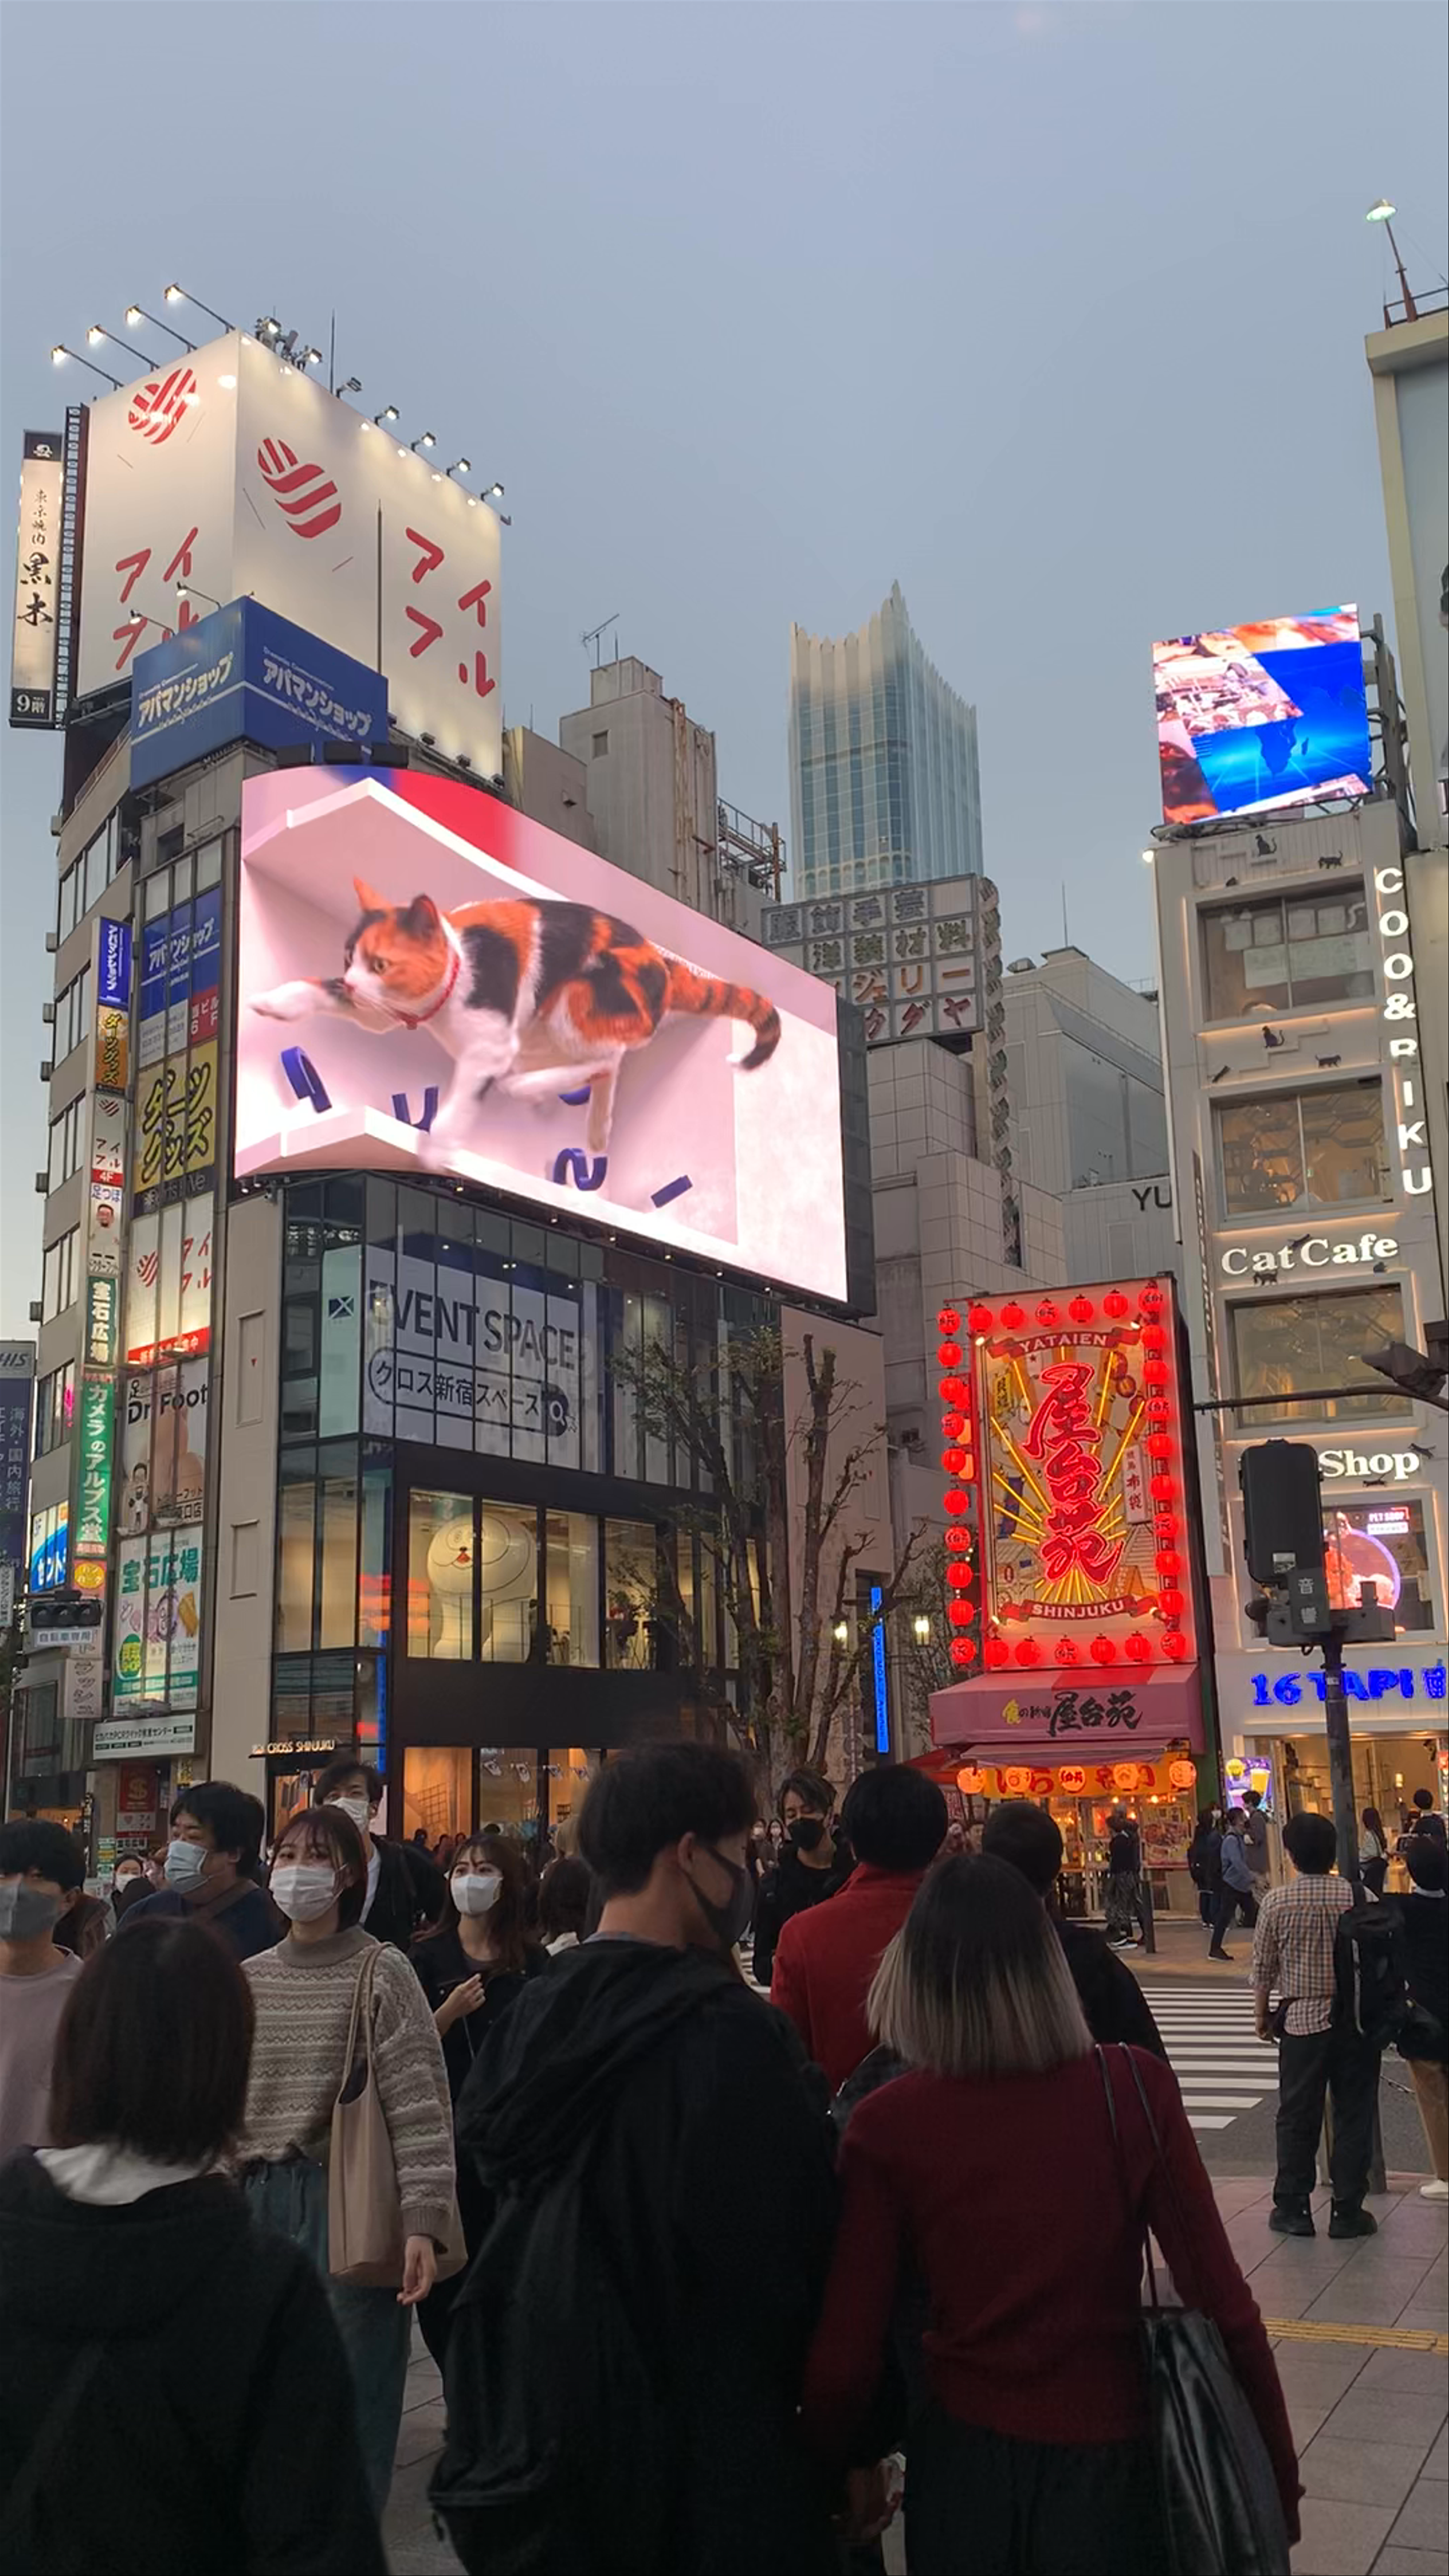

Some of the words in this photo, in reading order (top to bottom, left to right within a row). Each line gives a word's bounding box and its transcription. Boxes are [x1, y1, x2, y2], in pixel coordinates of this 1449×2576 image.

[17, 552, 53, 626] 黒木
[138, 652, 233, 726] アパマンショップ
[264, 658, 372, 736] アパマンショップ
[1221, 1246, 1294, 1275] Cat
[1300, 1233, 1398, 1266] Cafe
[91, 1281, 111, 1363] 宝石広場
[484, 1310, 574, 1370] SPACE
[1019, 1333, 1107, 1353] YATAIEN
[160, 1384, 208, 1415] Foot
[376, 1361, 540, 1416] クロス新宿スペース
[81, 1384, 108, 1542] カメラのアルプス堂
[1022, 1363, 1124, 1586] 屋台苑
[1318, 1450, 1420, 1481] Shop
[122, 1548, 198, 1594] 宝石広場
[1032, 1599, 1126, 1618] SHINJUKU
[1046, 1690, 1143, 1737] 屋台苑
[1251, 1673, 1302, 1706] 16
